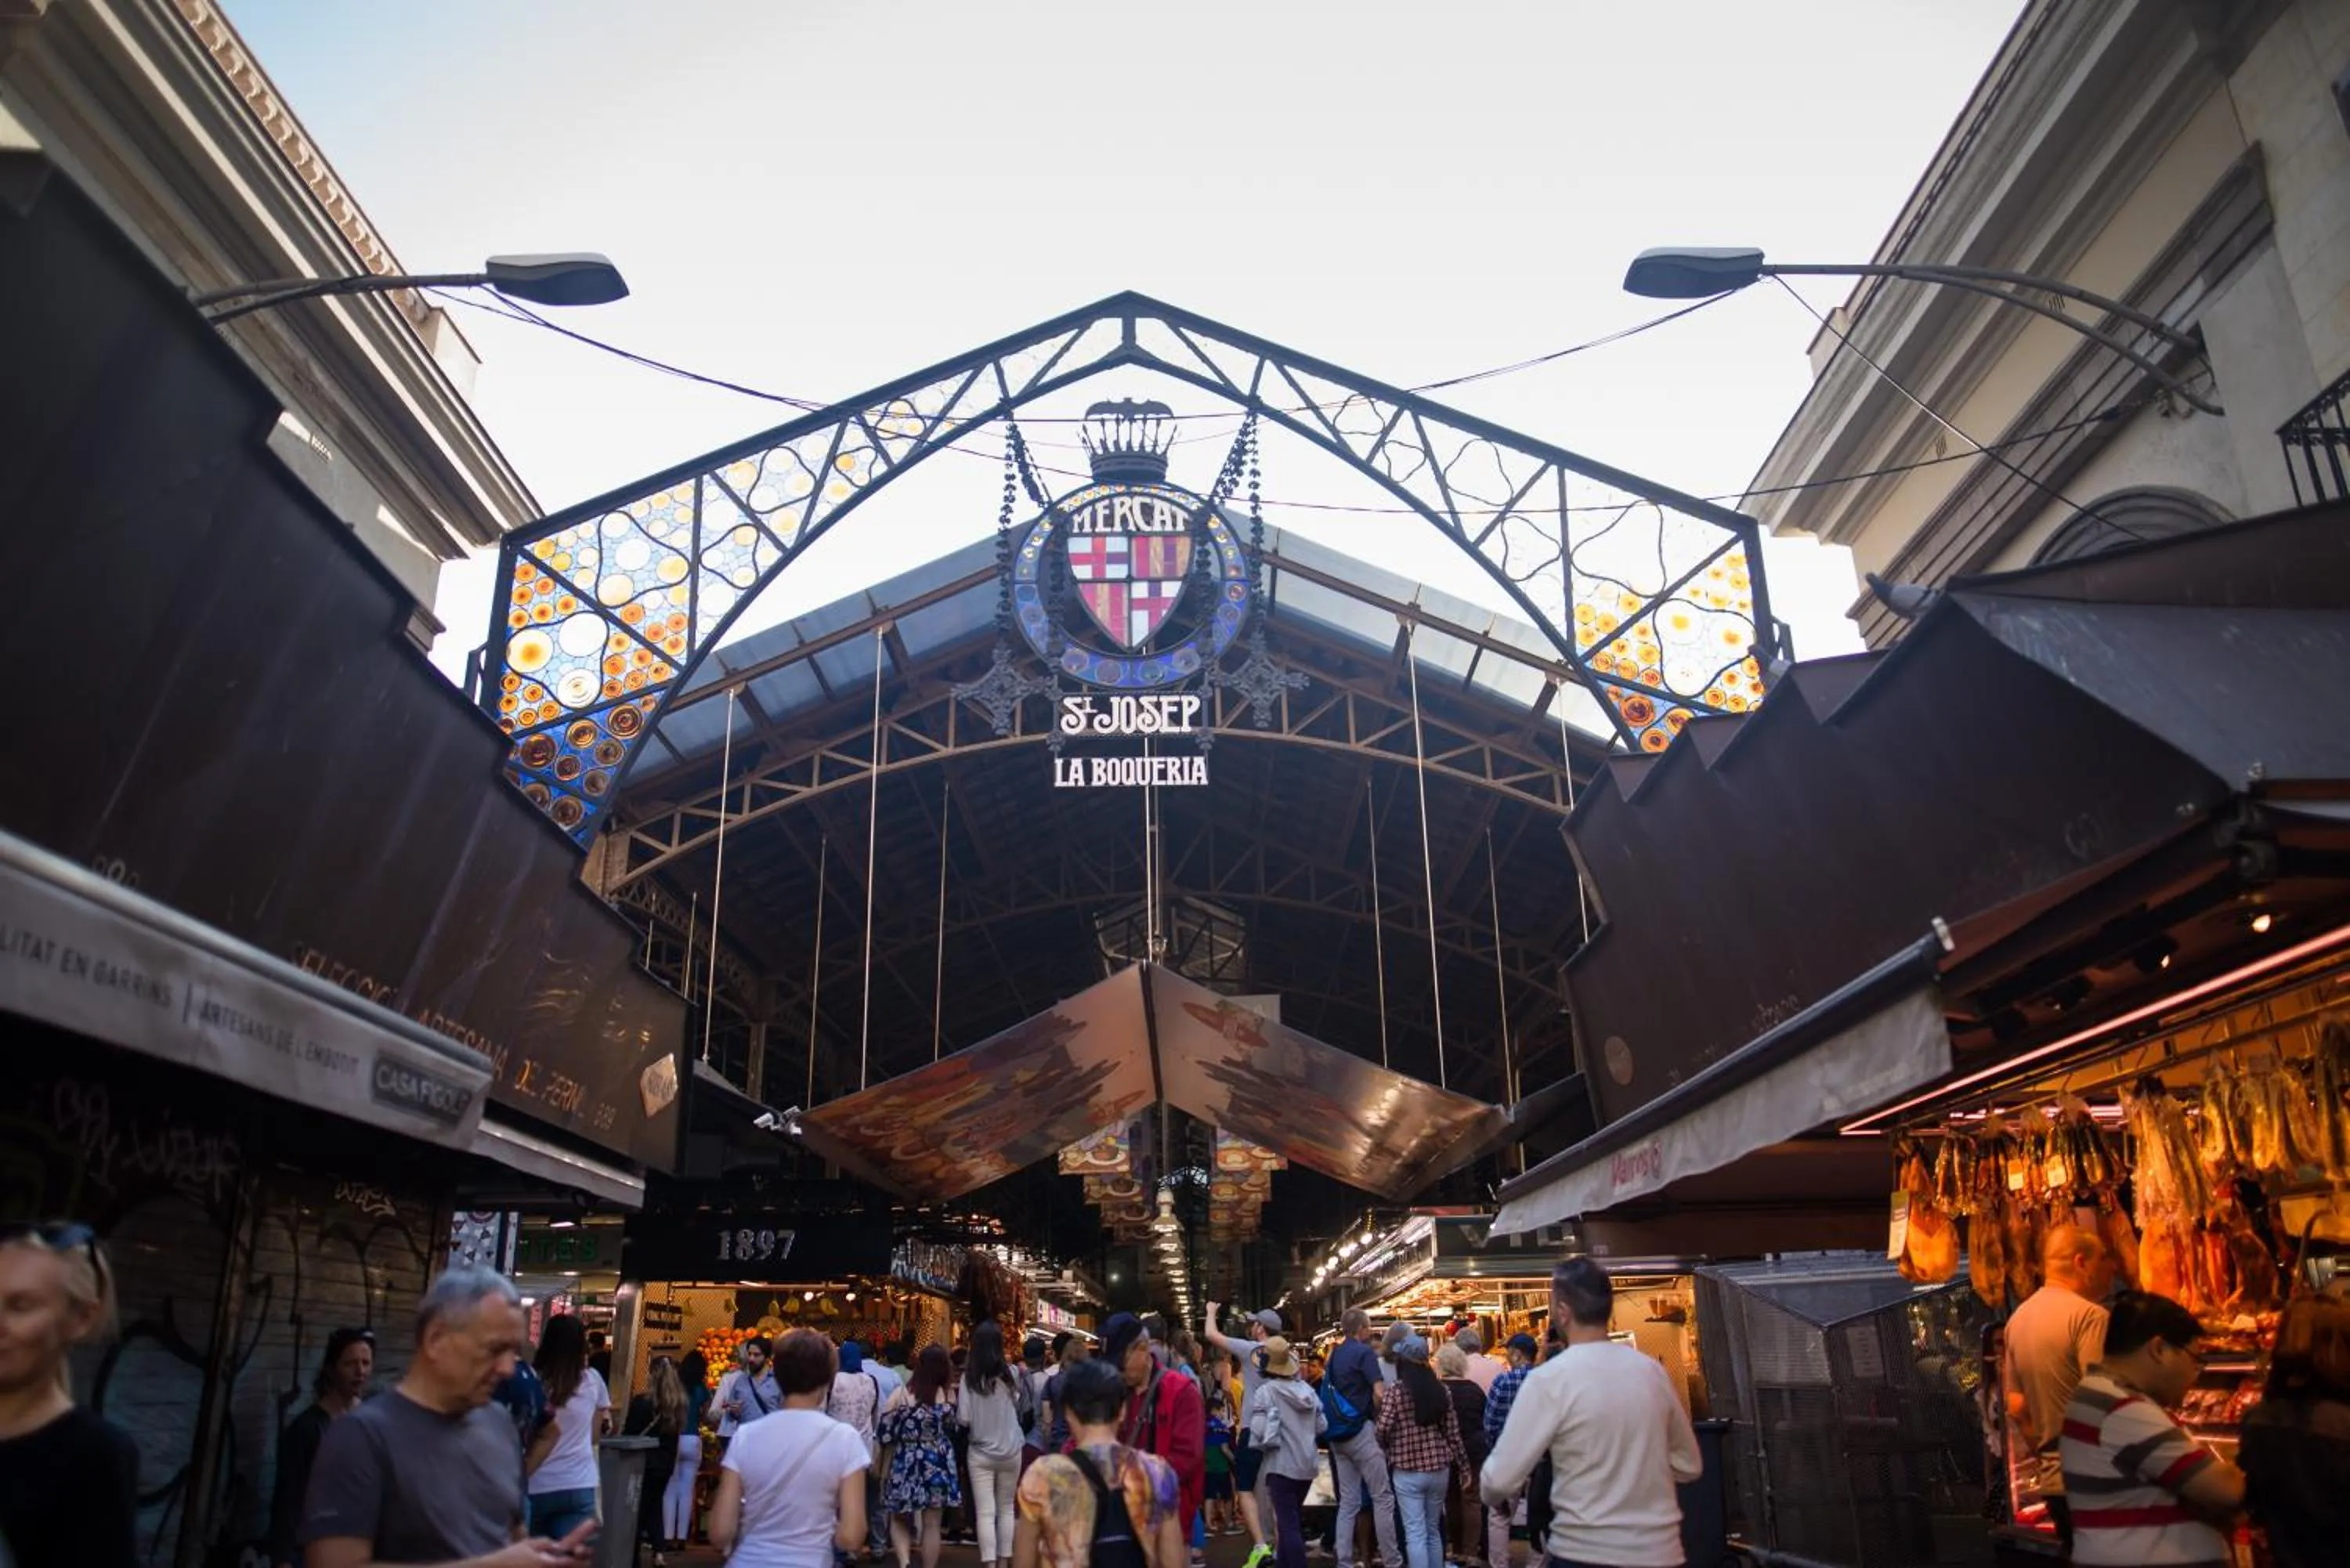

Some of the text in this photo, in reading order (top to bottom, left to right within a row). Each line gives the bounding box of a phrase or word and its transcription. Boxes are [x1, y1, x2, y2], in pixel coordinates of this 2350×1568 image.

[1072, 497, 1190, 533] MERCAT
[1094, 695, 1201, 734] JOSEP
[1054, 756, 1209, 787] LA BOQUERIA
[60, 945, 89, 979] EN
[716, 1227, 797, 1262] 1897
